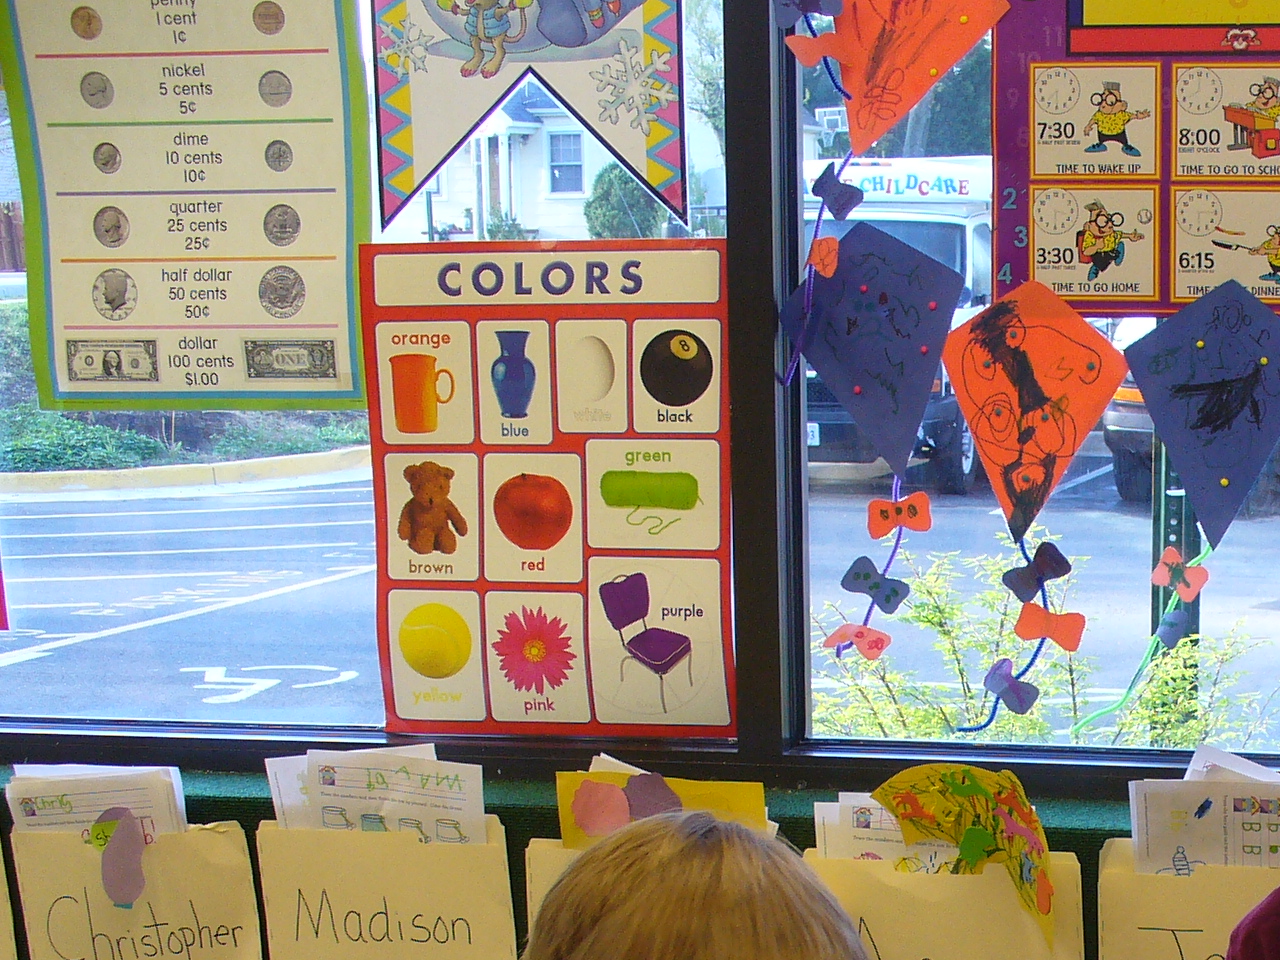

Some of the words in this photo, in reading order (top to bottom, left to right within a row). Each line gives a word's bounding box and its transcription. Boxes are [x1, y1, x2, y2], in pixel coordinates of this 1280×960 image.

[164, 12, 197, 25] cent
[162, 63, 206, 77] nickel
[159, 82, 168, 96] 5
[173, 82, 213, 96] cents
[179, 100, 197, 115] 5¢
[1037, 122, 1075, 140] 7:30
[1179, 128, 1221, 146] 8:00
[173, 132, 209, 147] dime
[165, 151, 180, 166] 10
[183, 151, 223, 165] cents
[183, 169, 206, 184] 10¢
[1056, 164, 1079, 173] TIME
[1083, 164, 1095, 173] TO
[1098, 164, 1125, 174] WAKE
[1128, 164, 1141, 173] UP
[1180, 165, 1203, 174] TIME
[1208, 165, 1220, 174] TO
[1224, 165, 1238, 174] GO
[1242, 165, 1255, 175] TO
[860, 174, 970, 196] CHILDCARE
[1002, 188, 1017, 209] 2
[169, 200, 223, 216] quarter
[167, 219, 185, 232] 25
[189, 218, 228, 232] cents
[185, 237, 210, 251] 25¢
[1014, 226, 1028, 248] 3
[1036, 247, 1074, 264] 3:30
[1179, 252, 1215, 269] 6:15
[161, 268, 190, 282] half
[193, 268, 232, 282] dollar
[437, 260, 644, 297] COLORS
[997, 262, 1012, 284] 4
[168, 287, 186, 301] 50
[189, 287, 227, 300] cents
[1051, 282, 1074, 293] TIME
[1078, 282, 1091, 292] TO
[1093, 282, 1108, 293] GO
[1111, 282, 1140, 292] HOME
[1187, 286, 1210, 296] TIME
[185, 305, 210, 320] 50¢
[178, 336, 218, 350] dollar
[391, 330, 451, 348] orange
[679, 339, 690, 352] 8
[167, 355, 190, 369] 100
[196, 355, 235, 369] cents
[185, 372, 219, 387] $1.00
[573, 408, 612, 423] white
[657, 409, 693, 424] black
[501, 423, 529, 438] blue
[625, 448, 671, 466] green
[408, 559, 453, 575] brown
[521, 557, 545, 573] red
[661, 603, 704, 620] purple
[413, 689, 462, 705] yellow
[523, 696, 555, 714] pink
[295, 888, 473, 945] Madison
